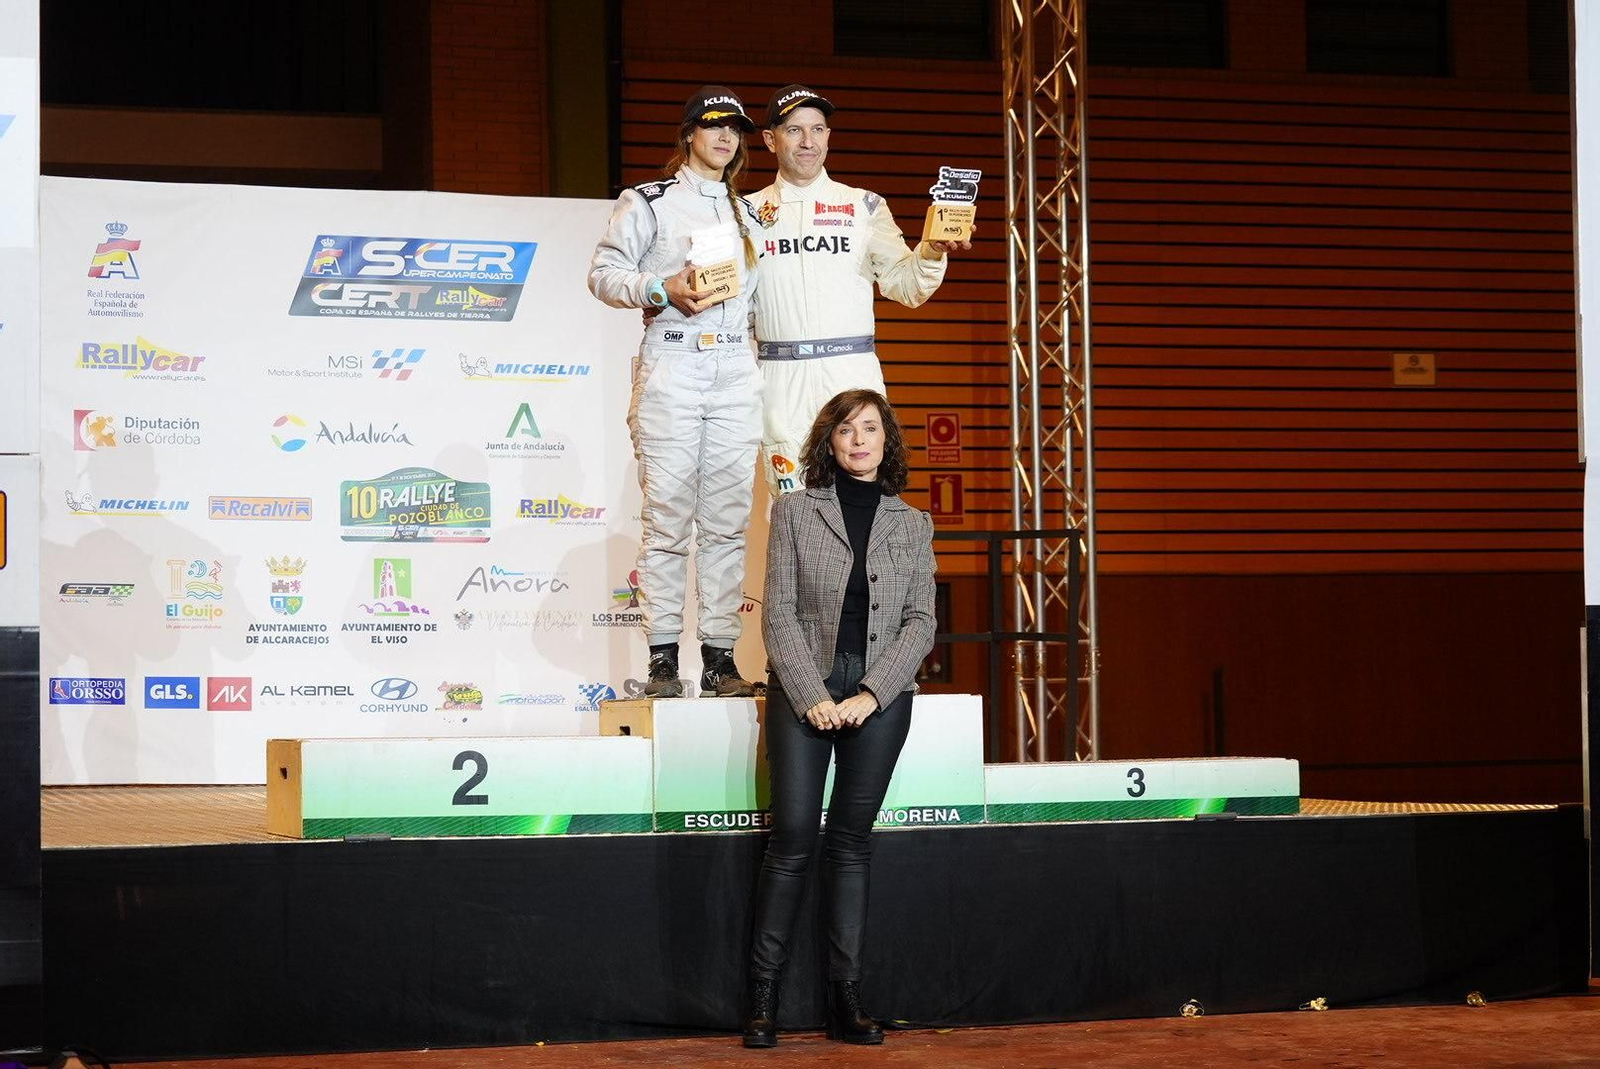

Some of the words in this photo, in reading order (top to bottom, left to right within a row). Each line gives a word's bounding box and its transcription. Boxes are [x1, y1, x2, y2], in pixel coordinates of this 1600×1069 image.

[827, 203, 854, 217] RACING
[87, 289, 103, 298] Real
[105, 290, 145, 300] Federación
[311, 282, 432, 310] CERT
[94, 299, 127, 310] Española
[129, 300, 138, 309] de
[87, 309, 144, 319] Automovilismo
[358, 308, 392, 317] ESPAÑA
[664, 332, 684, 341] OMP
[267, 369, 293, 377] Motor
[302, 370, 326, 378] Sport
[328, 370, 363, 378] Institute
[494, 363, 591, 376] MICHELIN
[124, 416, 200, 433] Diputación
[124, 431, 140, 444] de
[144, 430, 201, 446] Córdoba
[315, 420, 415, 447] Andalucía
[485, 441, 509, 451] Junta
[511, 442, 521, 450] de
[523, 442, 565, 451] Andalucía
[380, 481, 456, 509] RALLYE
[100, 499, 190, 511] MICHELIN
[346, 485, 377, 519] 10
[421, 504, 447, 512] CIUDAD
[450, 502, 460, 510] DE
[228, 500, 294, 518] Recalvi
[389, 507, 485, 525] POZOBLANCO
[166, 603, 178, 617] El
[181, 603, 223, 621] Guijo
[592, 613, 613, 622] LOS
[248, 624, 327, 632] AYUNTAMIENTO
[341, 623, 422, 632] AYUNTAMIENTO
[424, 624, 437, 632] DE
[246, 635, 259, 644] DE
[262, 635, 330, 645] ALCARACEJOS
[371, 636, 383, 644] EL
[386, 636, 408, 644] VISO
[72, 680, 123, 688] ORTOPEDIA
[72, 687, 124, 699] ORSSO
[260, 685, 285, 696] AL
[360, 703, 428, 713] CORHYUND
[452, 750, 488, 805] 2
[1127, 767, 1146, 798] 3
[879, 808, 961, 824] MORENA
